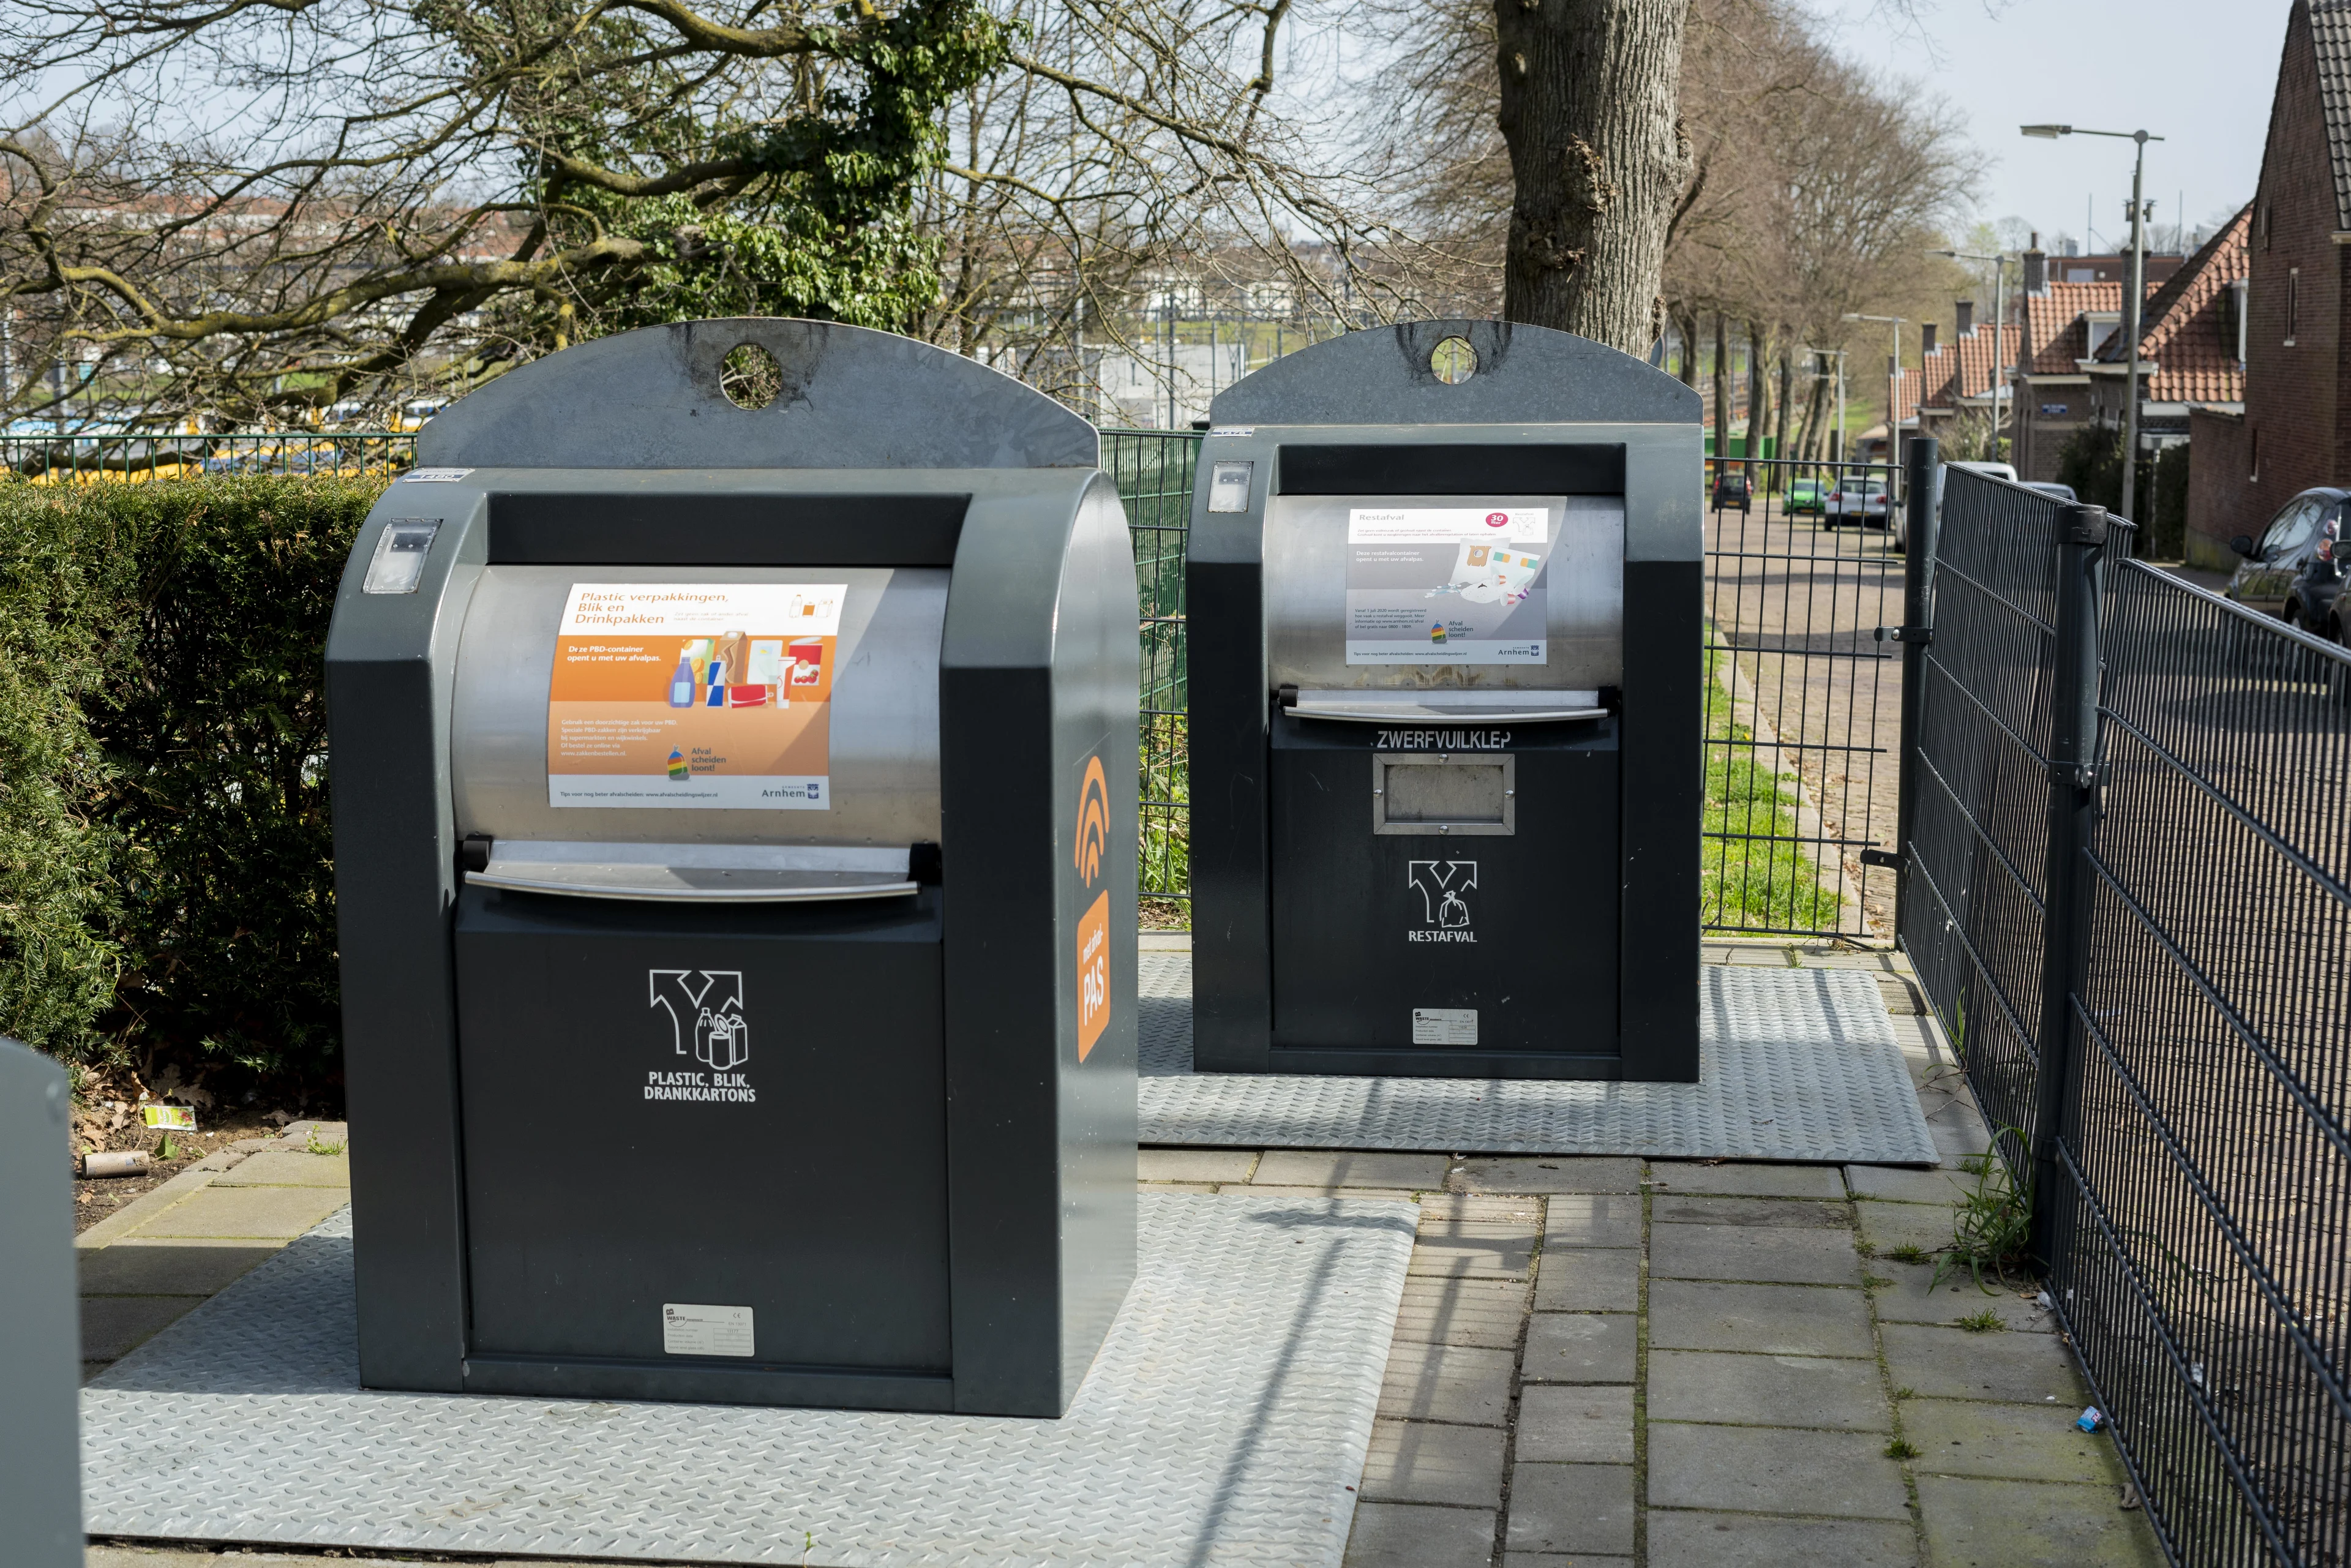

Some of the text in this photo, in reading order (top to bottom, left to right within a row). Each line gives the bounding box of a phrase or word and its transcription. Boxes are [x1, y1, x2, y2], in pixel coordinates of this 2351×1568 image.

[581, 593, 729, 603] Plastic verpakkingen,
[578, 603, 604, 612] Blik
[575, 614, 664, 626] Drinkpakken
[1377, 731, 1510, 748] ZWERFVUILKLEP
[1408, 930, 1477, 942] RESTAFVAL
[1083, 936, 1092, 965] met
[1084, 955, 1104, 1026] PAS
[649, 1071, 750, 1088] PLASTIC, BLIK,
[644, 1086, 756, 1102] DRANKKARTONS
